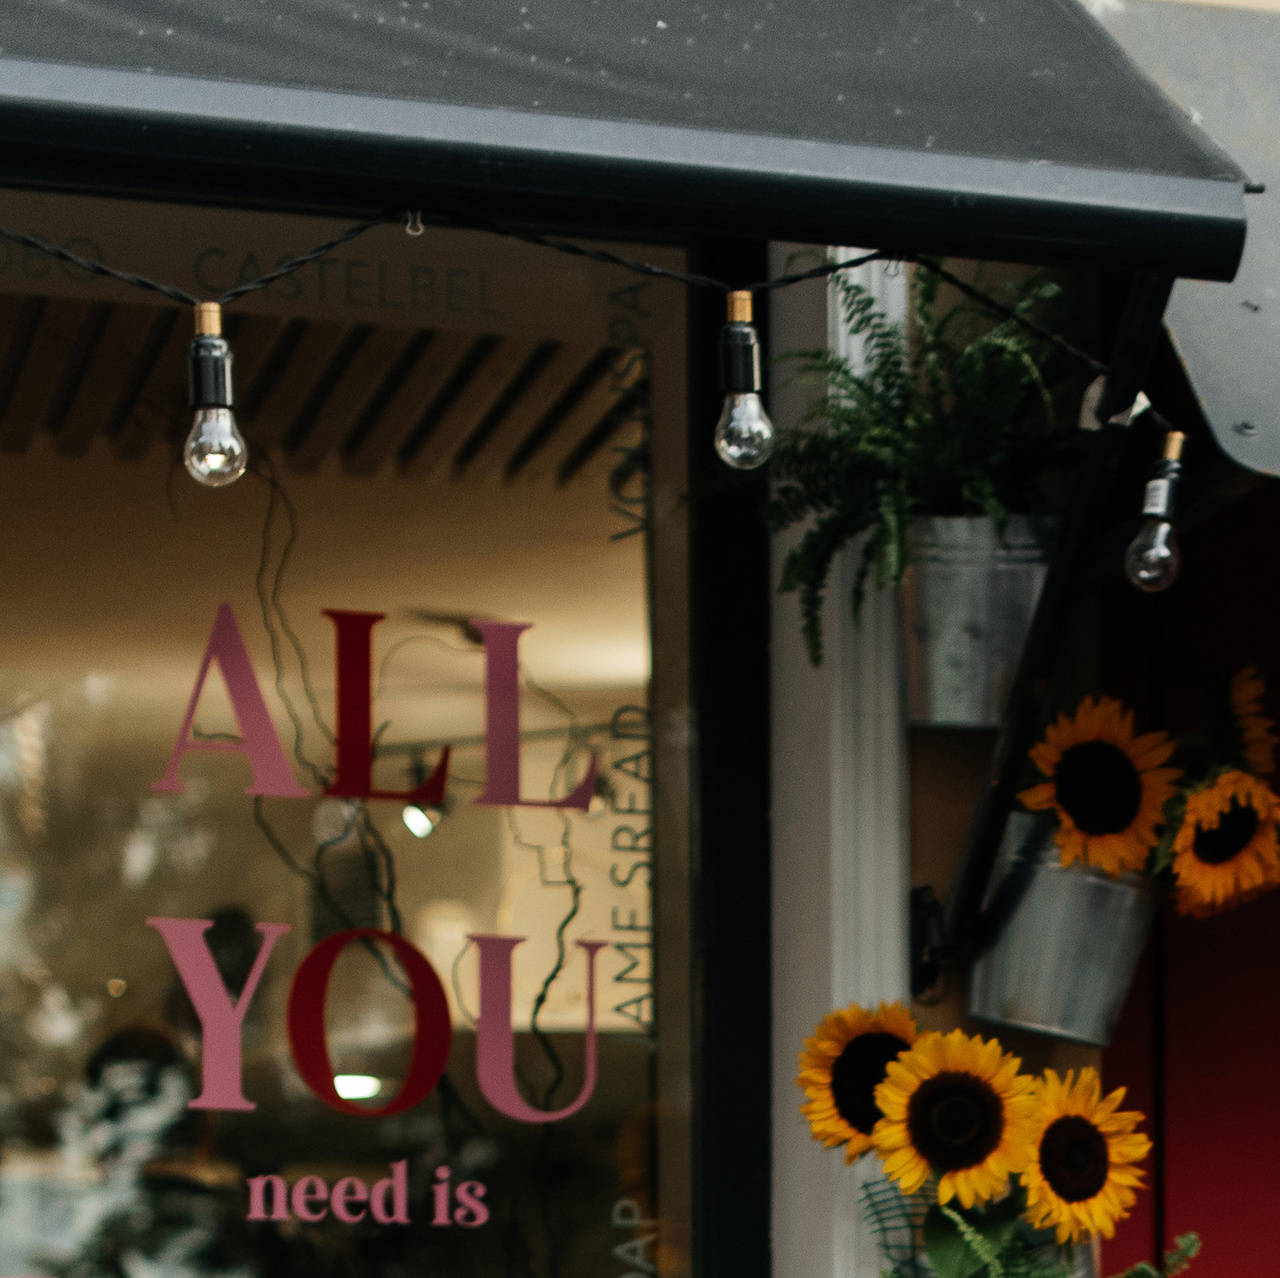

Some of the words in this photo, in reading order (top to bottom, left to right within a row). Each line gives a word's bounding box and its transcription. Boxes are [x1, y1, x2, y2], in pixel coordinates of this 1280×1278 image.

[192, 245, 506, 315] CASTELBEL
[150, 602, 600, 811] ALL
[146, 916, 609, 1124] YOU
[246, 1160, 409, 1226] need
[432, 1166, 491, 1227] is
